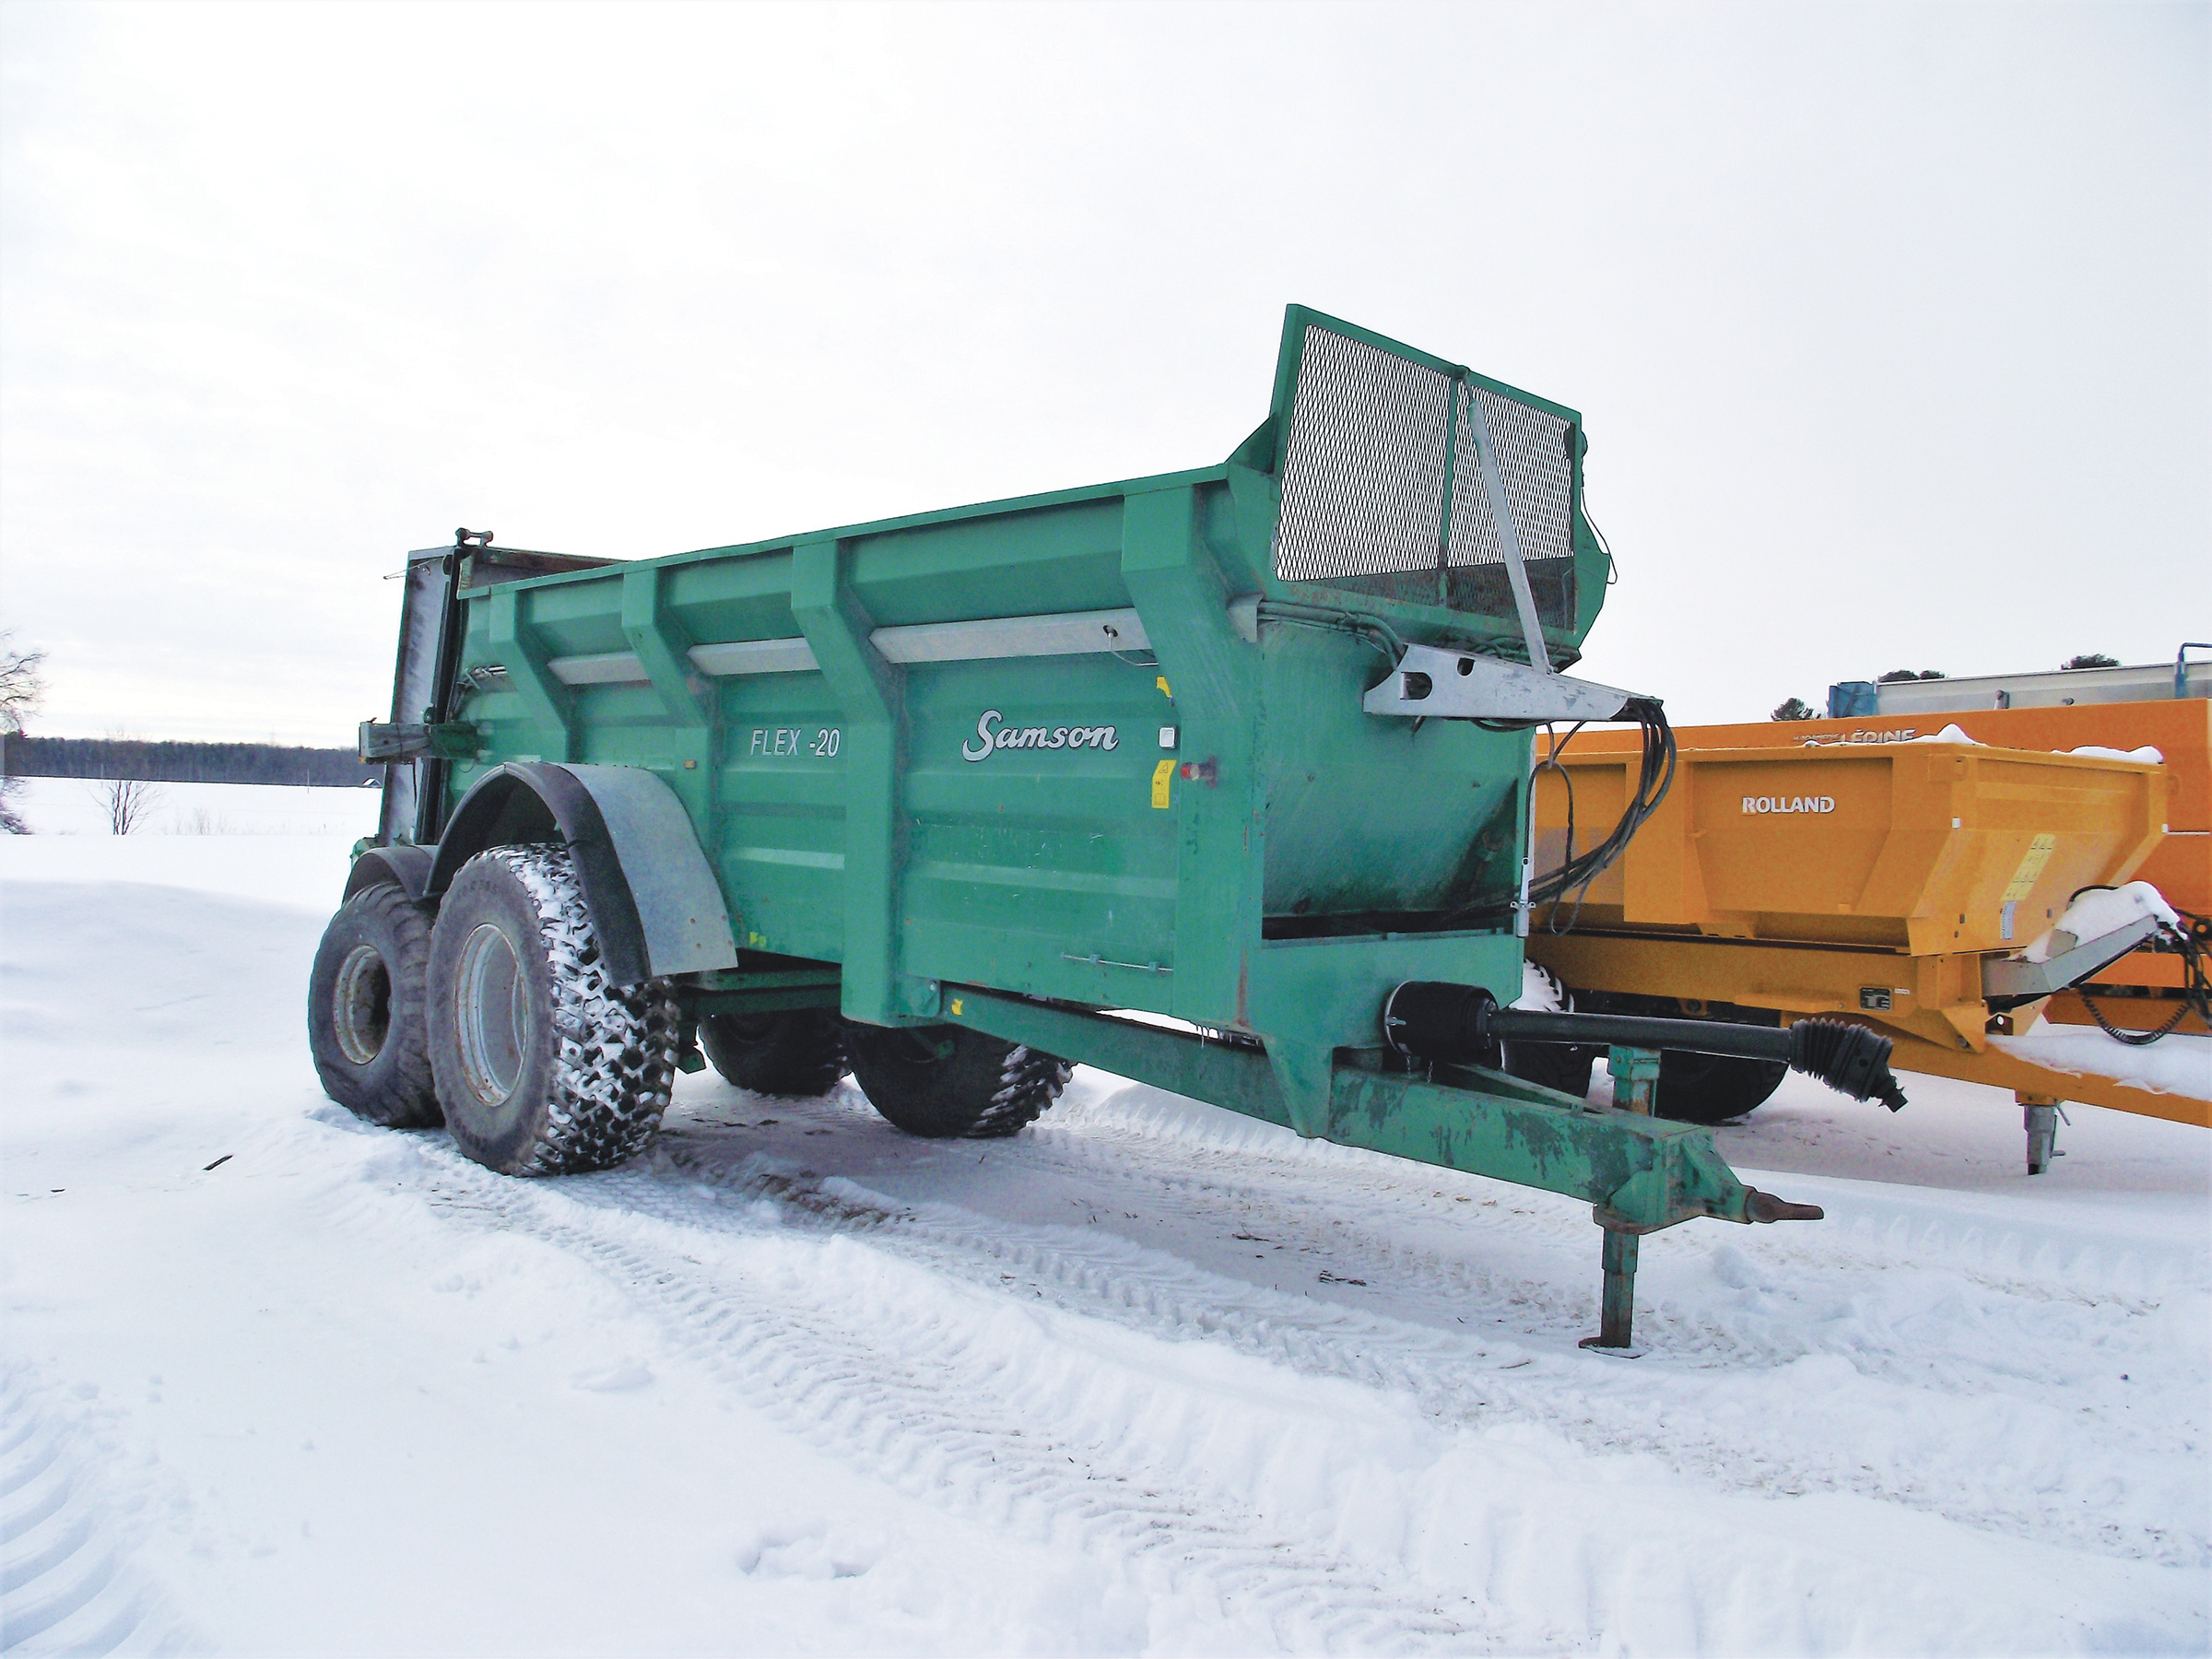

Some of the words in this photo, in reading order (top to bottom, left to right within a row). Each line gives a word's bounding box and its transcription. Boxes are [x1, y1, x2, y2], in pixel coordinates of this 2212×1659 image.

[750, 728, 802, 756] FLEX
[809, 727, 841, 758] -20
[961, 709, 1118, 762] Samson
[1742, 795, 1836, 814] ROLLAND
